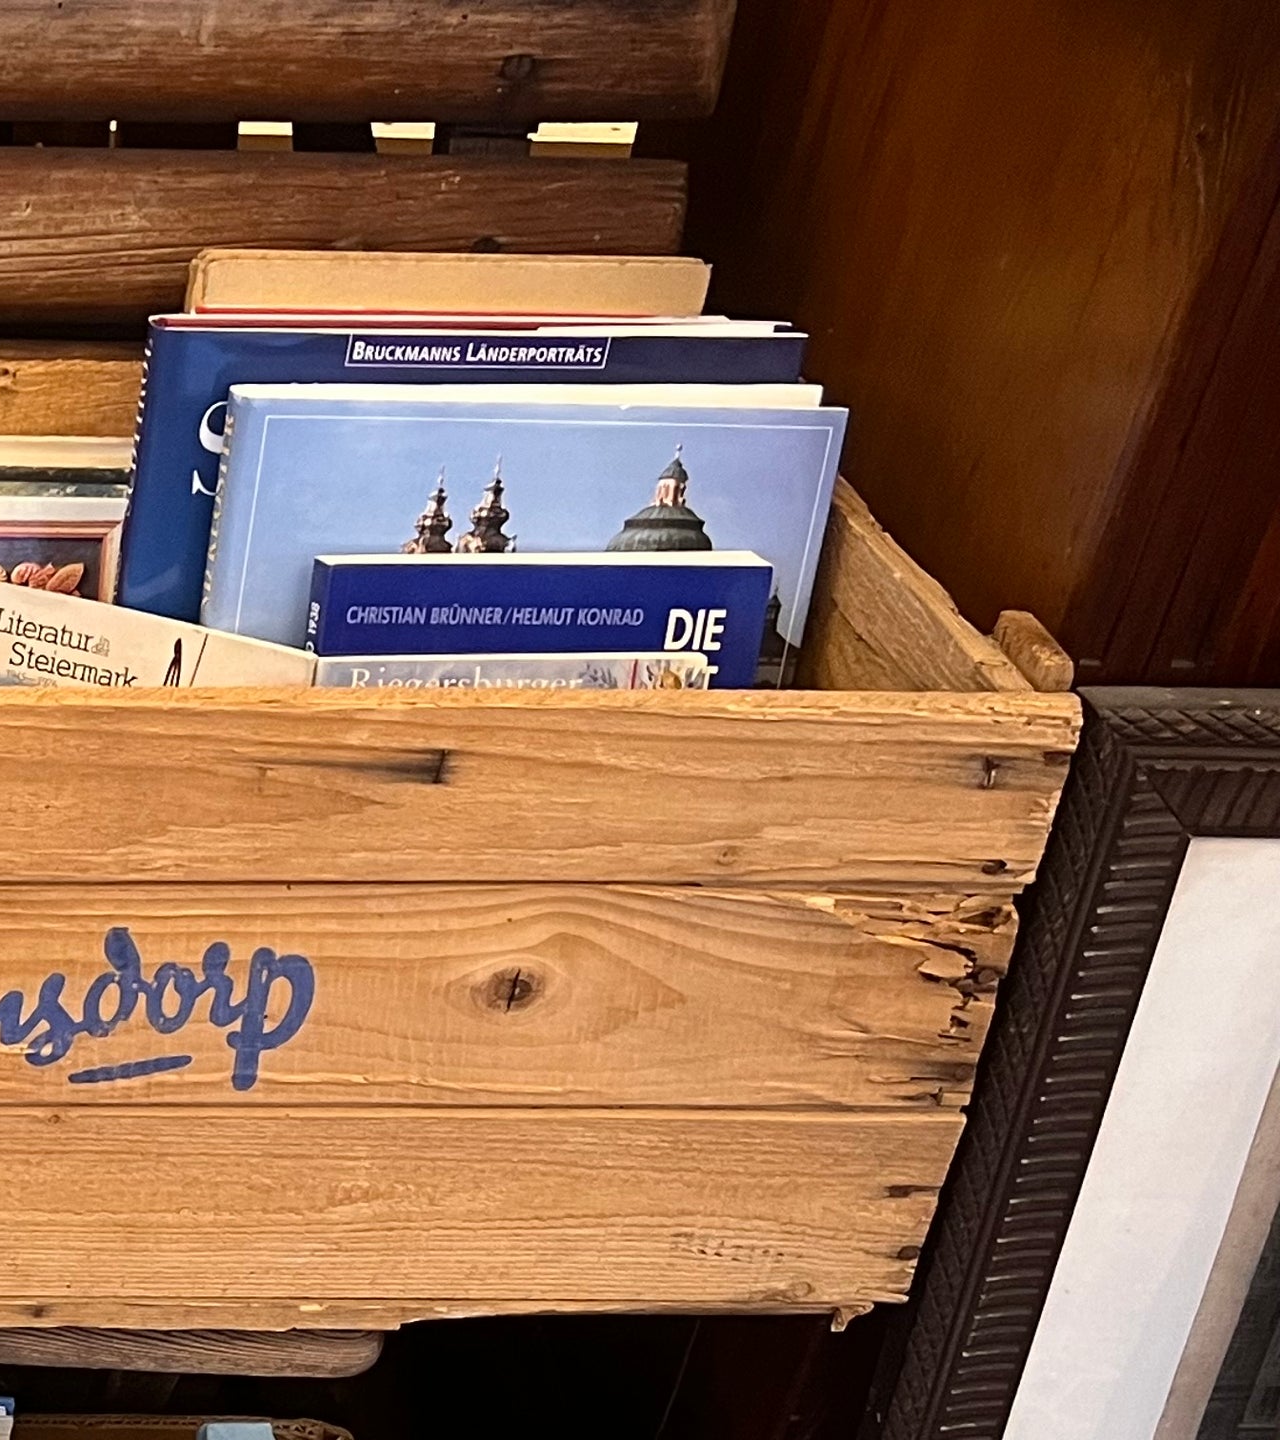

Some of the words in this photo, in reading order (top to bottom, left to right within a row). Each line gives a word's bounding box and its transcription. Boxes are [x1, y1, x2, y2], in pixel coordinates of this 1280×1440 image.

[352, 340, 461, 362] BRUCKMANNS
[466, 340, 603, 364] LÄNDERPORTRÄTS
[346, 605, 427, 625] CHRISTIAN
[576, 608, 644, 627] KONRAD
[663, 609, 727, 651] DIE
[9, 641, 138, 687] Steiermark
